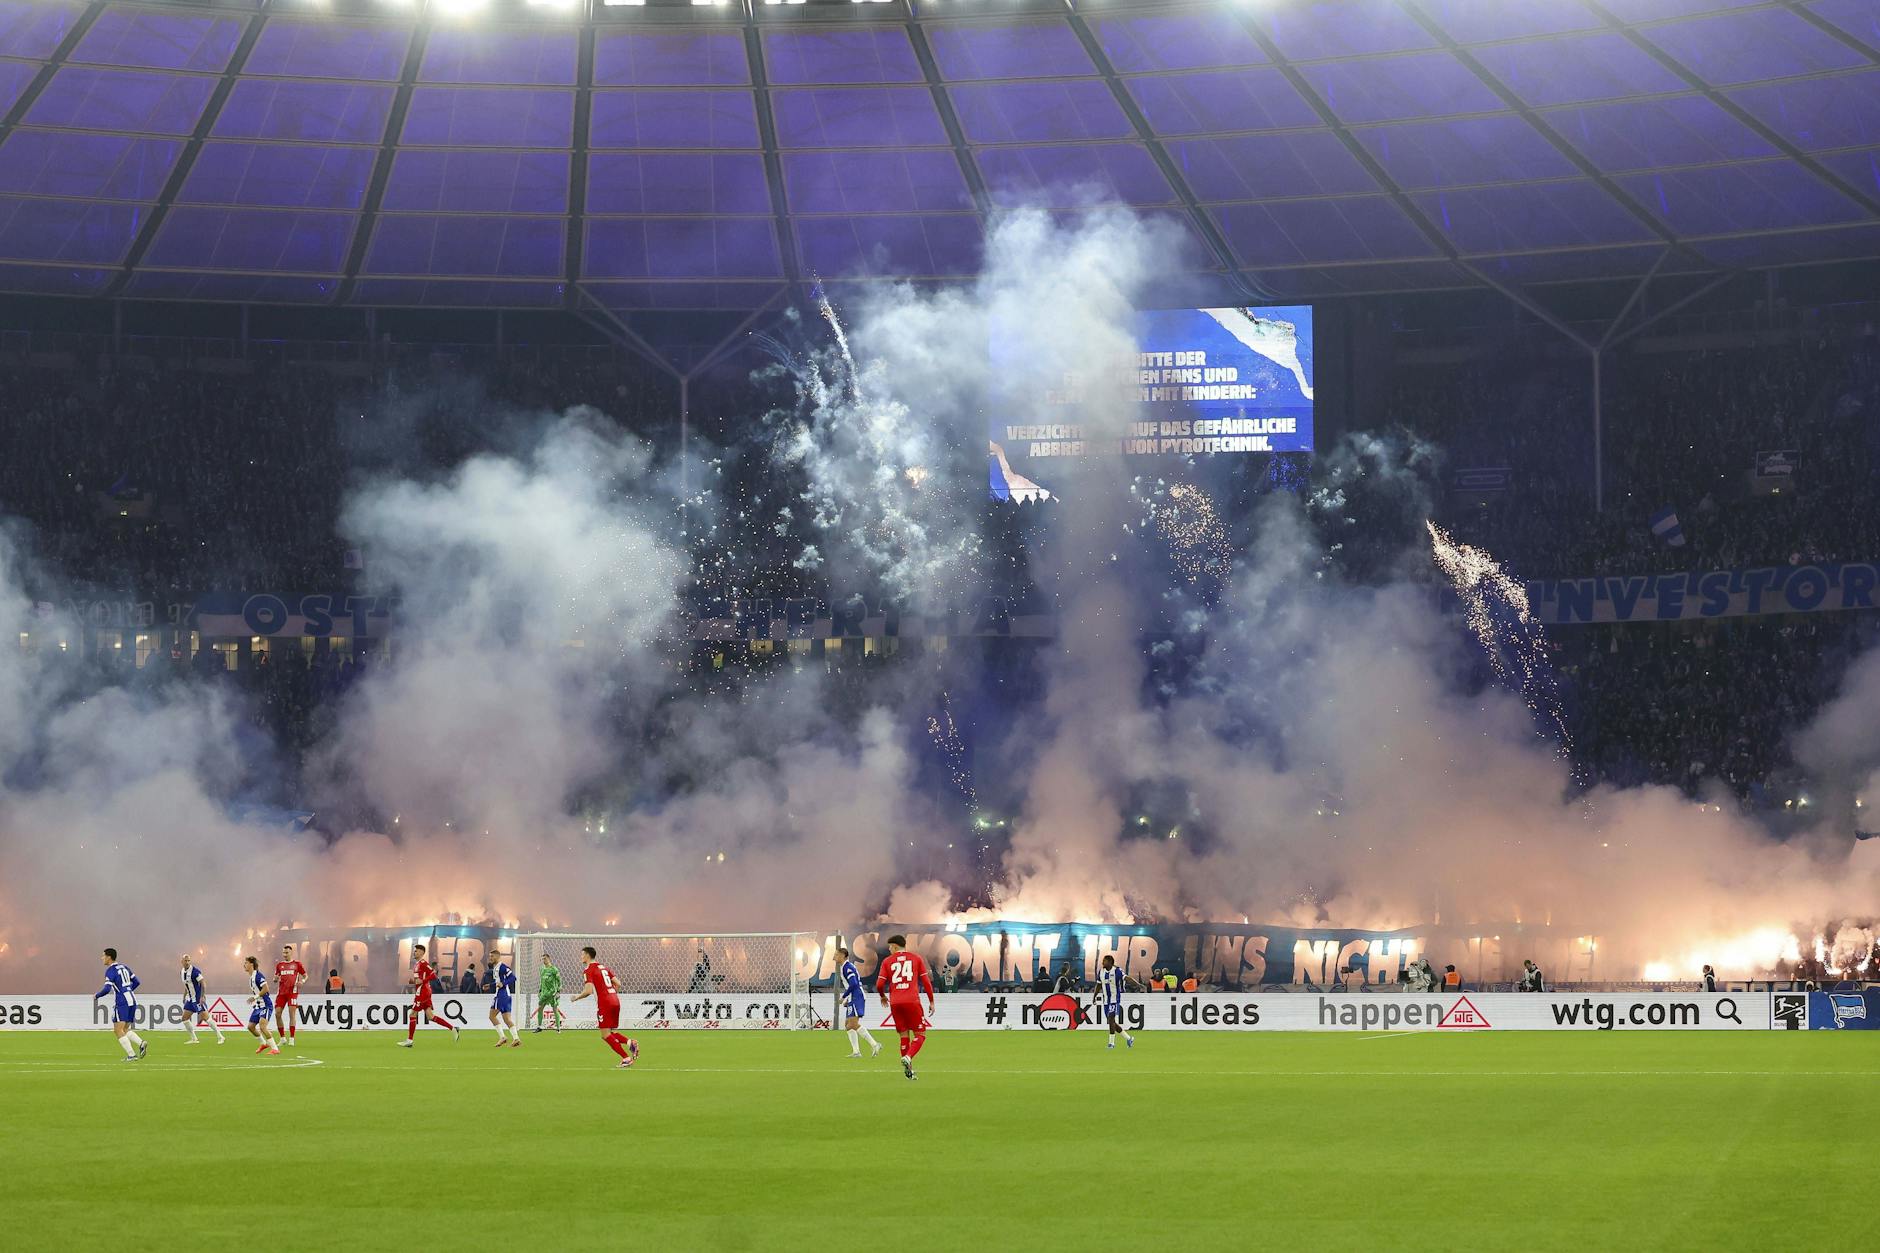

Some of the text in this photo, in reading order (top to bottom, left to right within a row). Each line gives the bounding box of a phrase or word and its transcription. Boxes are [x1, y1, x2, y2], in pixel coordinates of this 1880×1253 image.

[1175, 351, 1206, 366] DER
[1162, 368, 1202, 384] FANS
[1204, 367, 1238, 384] UND
[1152, 386, 1179, 402] MIT
[1183, 384, 1257, 401] KINDERN:
[1161, 420, 1191, 436] DAS
[1193, 417, 1297, 435] GEFÄHRLICHE
[1161, 435, 1272, 453] PYROTECHNIK.
[1083, 933, 1159, 982] IHR
[1184, 934, 1269, 985] UNS
[1293, 937, 1425, 985] NICHT
[117, 968, 131, 988] 10
[601, 969, 613, 988] 6
[890, 960, 914, 984] 24
[1171, 996, 1260, 1025] ideas
[1319, 997, 1444, 1030] happen
[1454, 1010, 1473, 1023] WTG
[1552, 998, 1700, 1030] wtg.com
